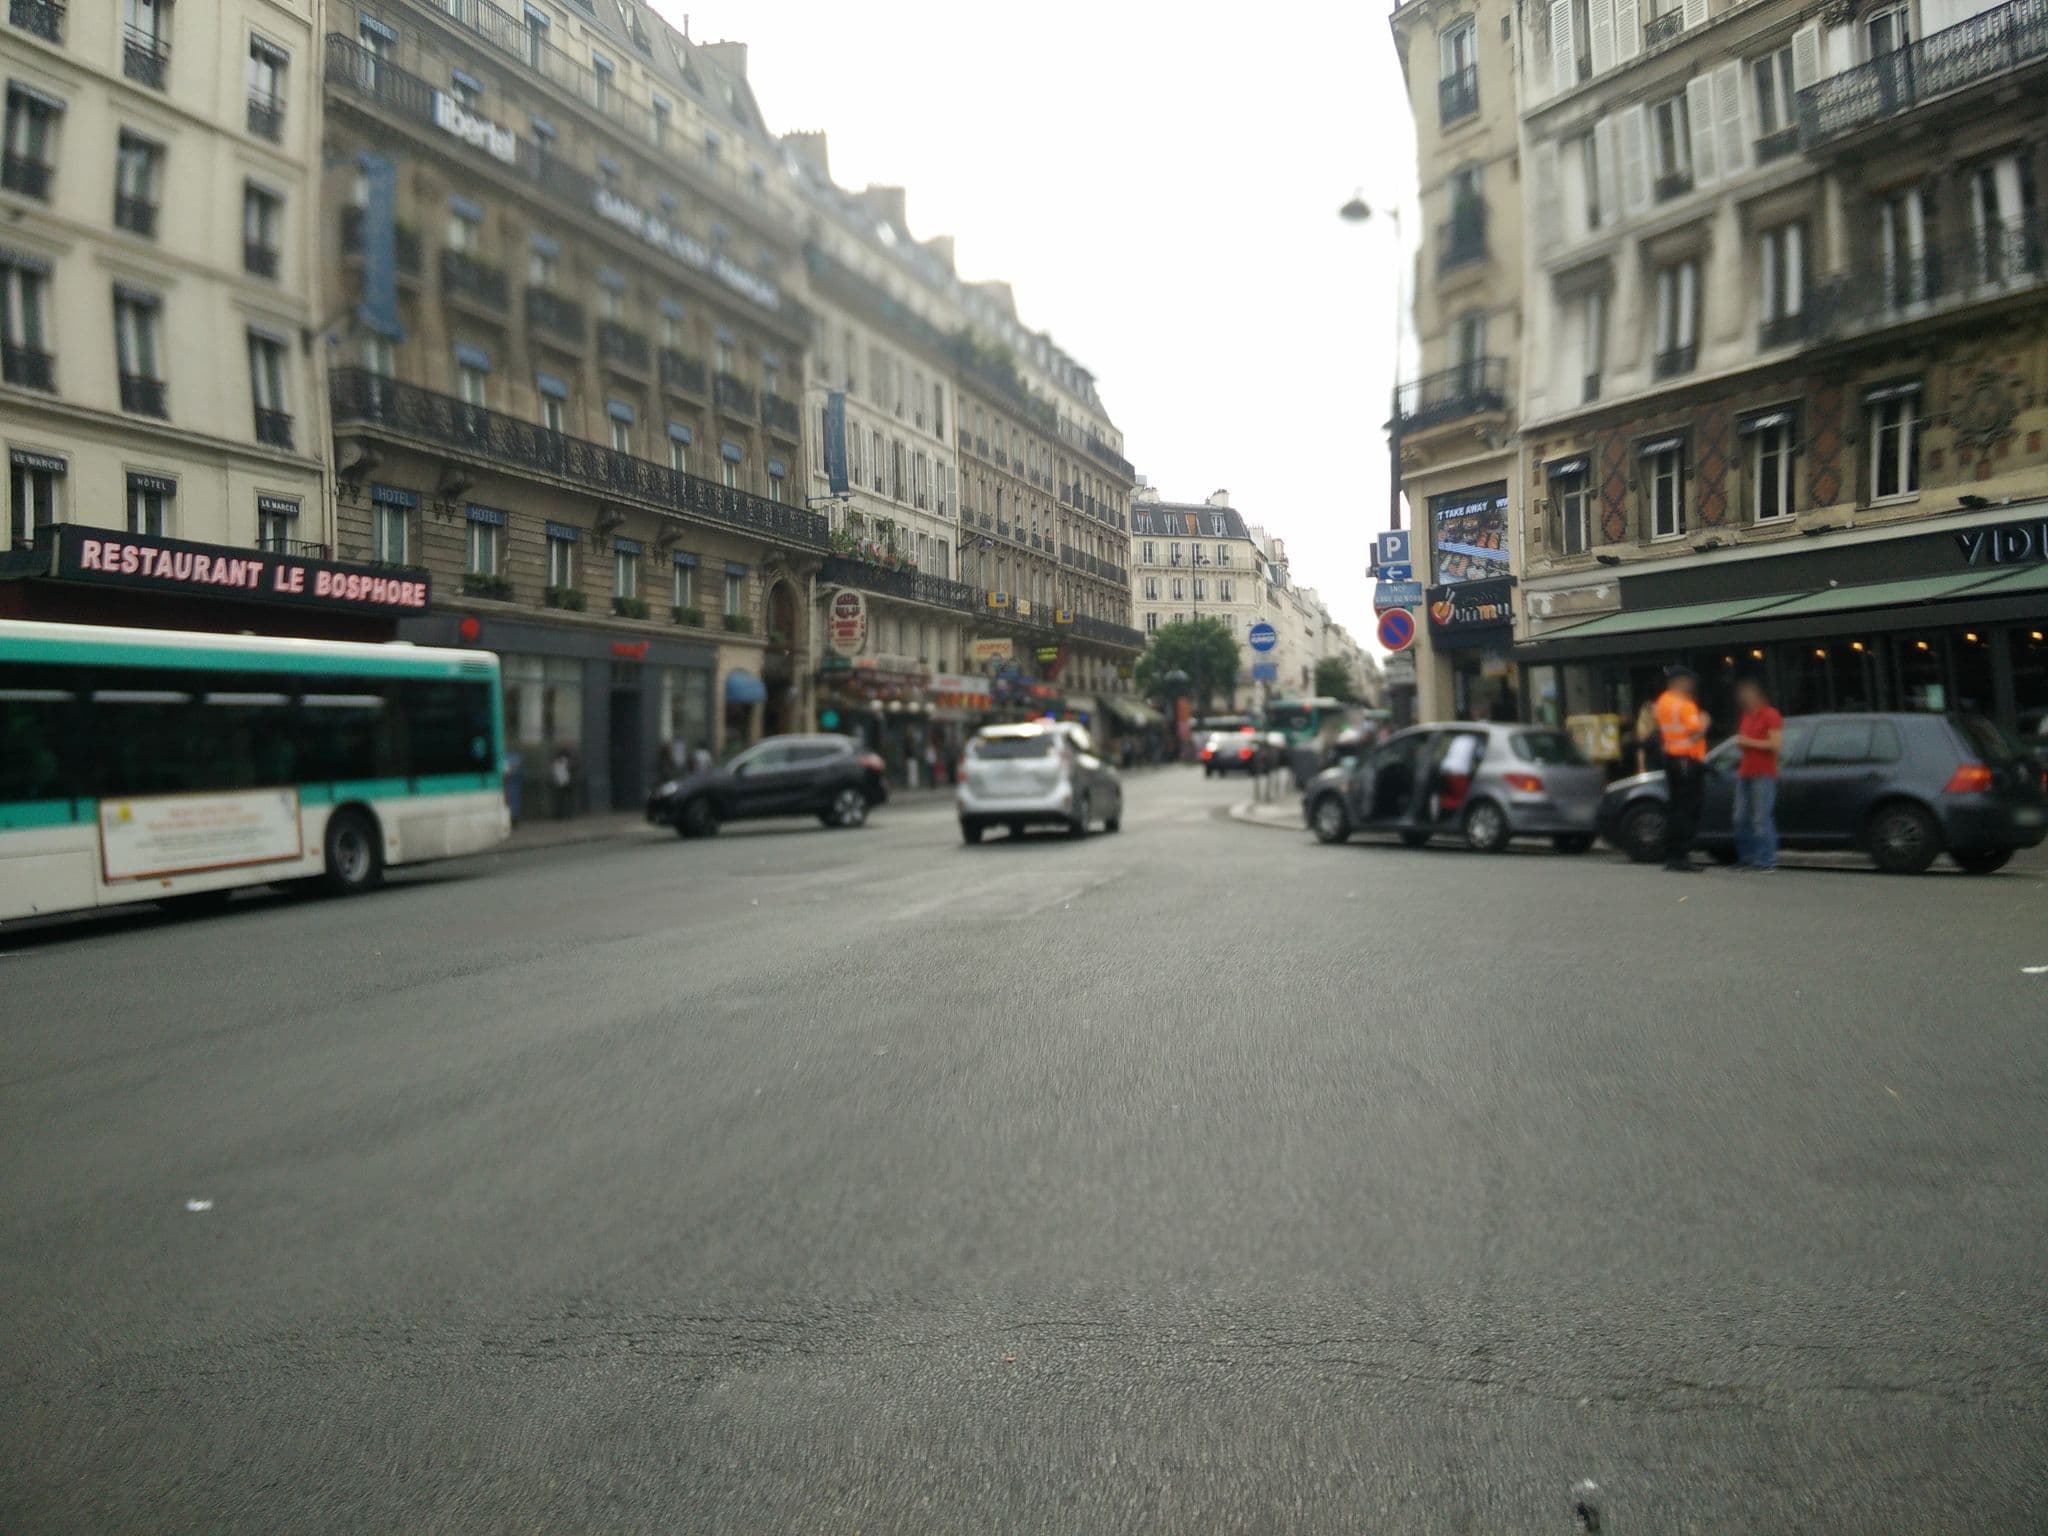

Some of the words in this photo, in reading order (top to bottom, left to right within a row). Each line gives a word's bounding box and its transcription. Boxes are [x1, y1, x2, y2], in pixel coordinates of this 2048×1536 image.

[366, 17, 391, 39] HOTEL
[14, 453, 26, 465] LE
[28, 456, 65, 472] MARCEL
[260, 499, 271, 510] LE
[272, 500, 298, 514] MARCEL
[1445, 507, 1465, 519] TAKE
[1465, 501, 1489, 515] AWAY
[1387, 537, 1400, 558] P
[82, 539, 263, 588] RESTAURANT
[275, 565, 304, 594] LE
[314, 570, 427, 609] BOSPHORE
